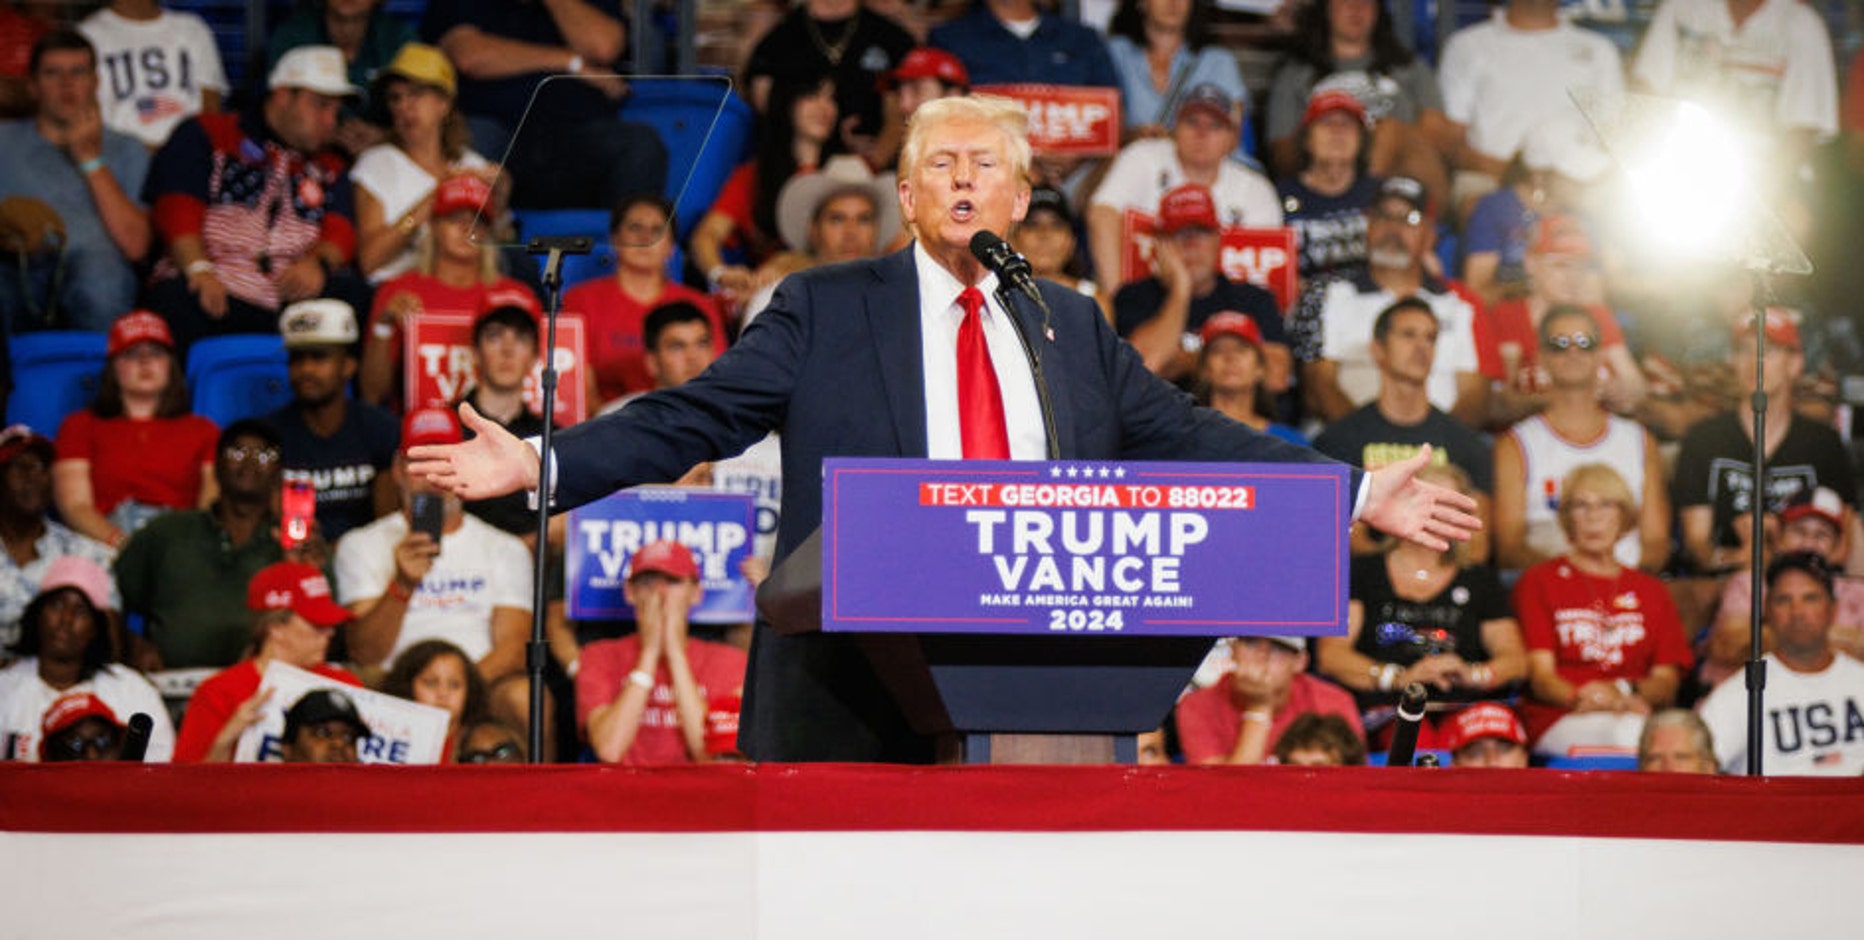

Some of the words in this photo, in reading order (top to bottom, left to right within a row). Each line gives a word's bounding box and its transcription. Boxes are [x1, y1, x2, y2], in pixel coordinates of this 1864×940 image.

[929, 484, 993, 505] TEXT
[1000, 484, 1120, 507] GEORGIA
[1126, 486, 1162, 507] TO
[1168, 487, 1248, 508] 88022
[579, 520, 747, 553] TRUMP
[966, 510, 1209, 556] TRUMP
[993, 555, 1180, 592] VANCE
[980, 594, 1021, 606] MAKE
[1024, 594, 1089, 607] AMERICA
[1092, 595, 1139, 608] GREAT
[1143, 595, 1194, 608] AGAIN!
[1049, 609, 1124, 631] 2024
[1769, 697, 1864, 753] USA
